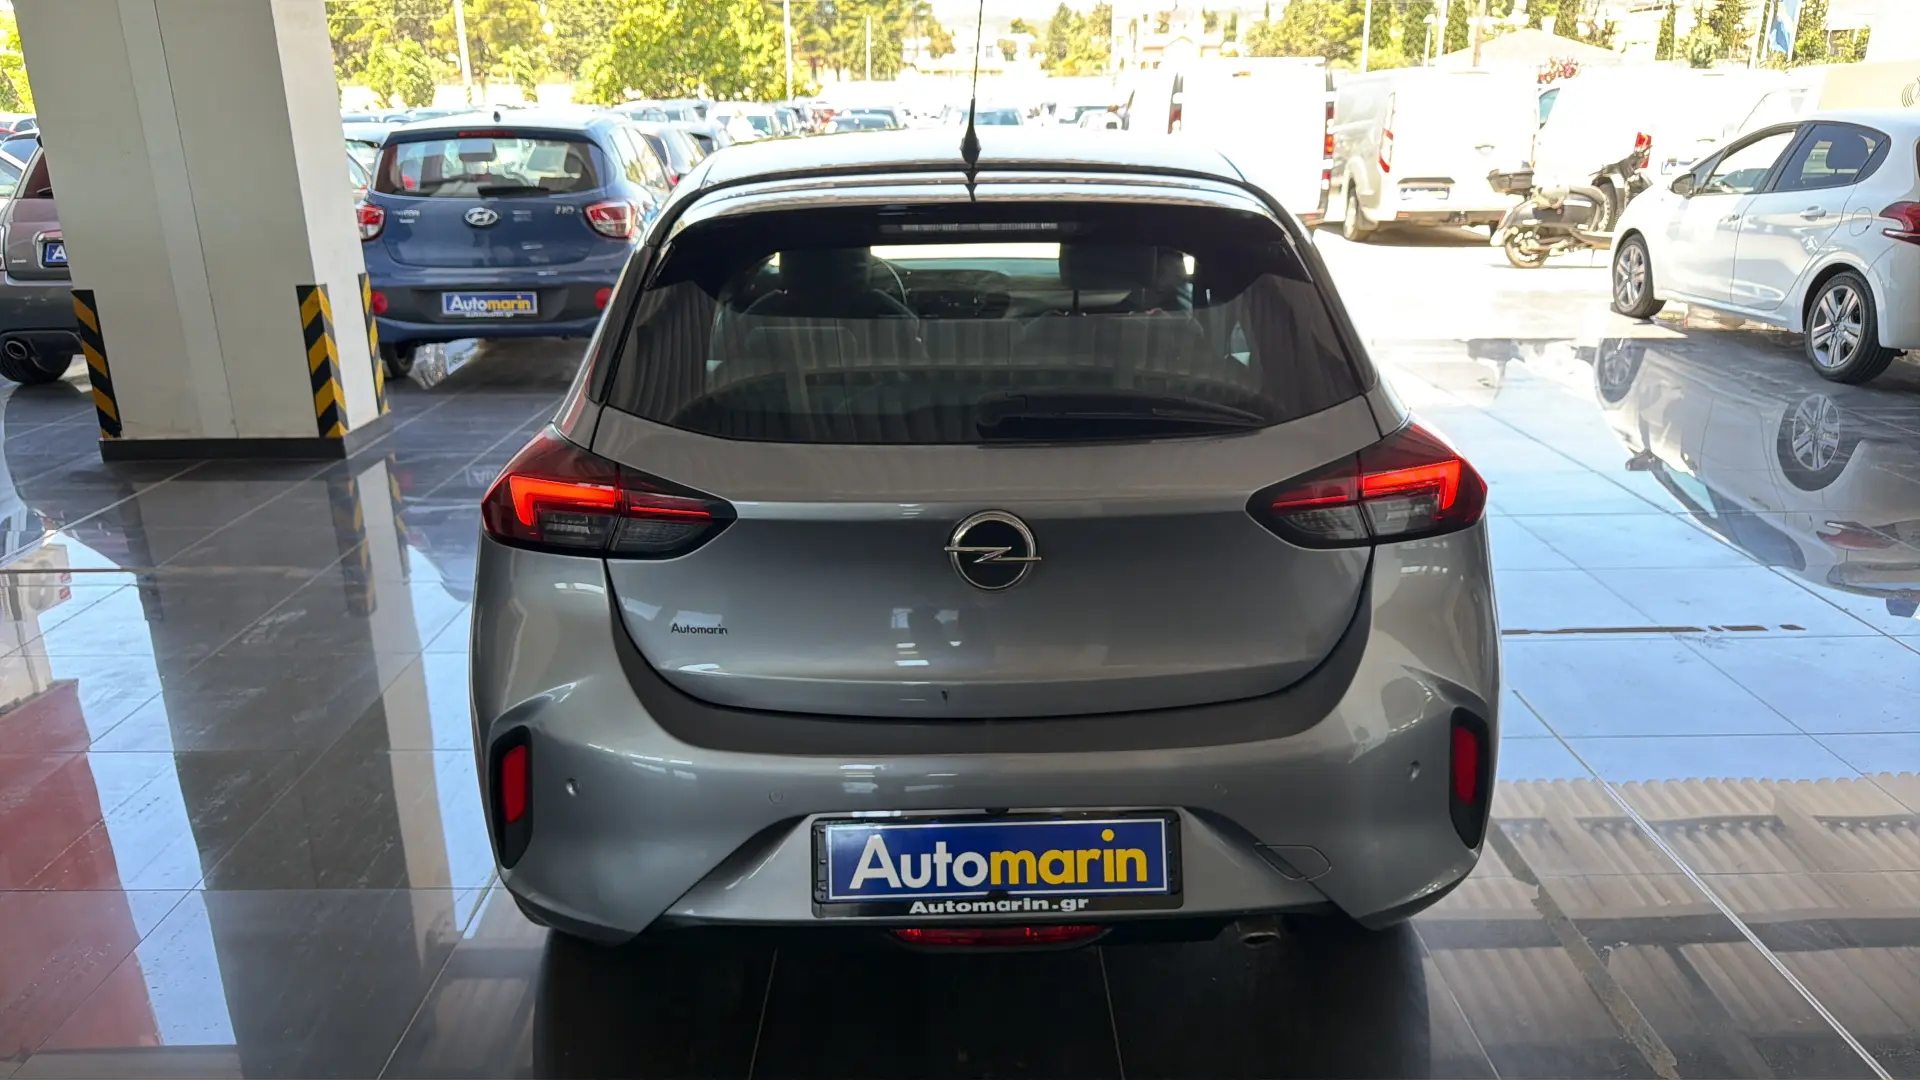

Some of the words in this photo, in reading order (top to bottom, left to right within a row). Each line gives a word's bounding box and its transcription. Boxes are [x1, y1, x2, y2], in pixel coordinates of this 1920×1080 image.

[450, 294, 531, 311] Automarin
[671, 622, 728, 635] Automarin
[849, 829, 1148, 890] Automarin
[909, 897, 1089, 915] Automarin.gr
